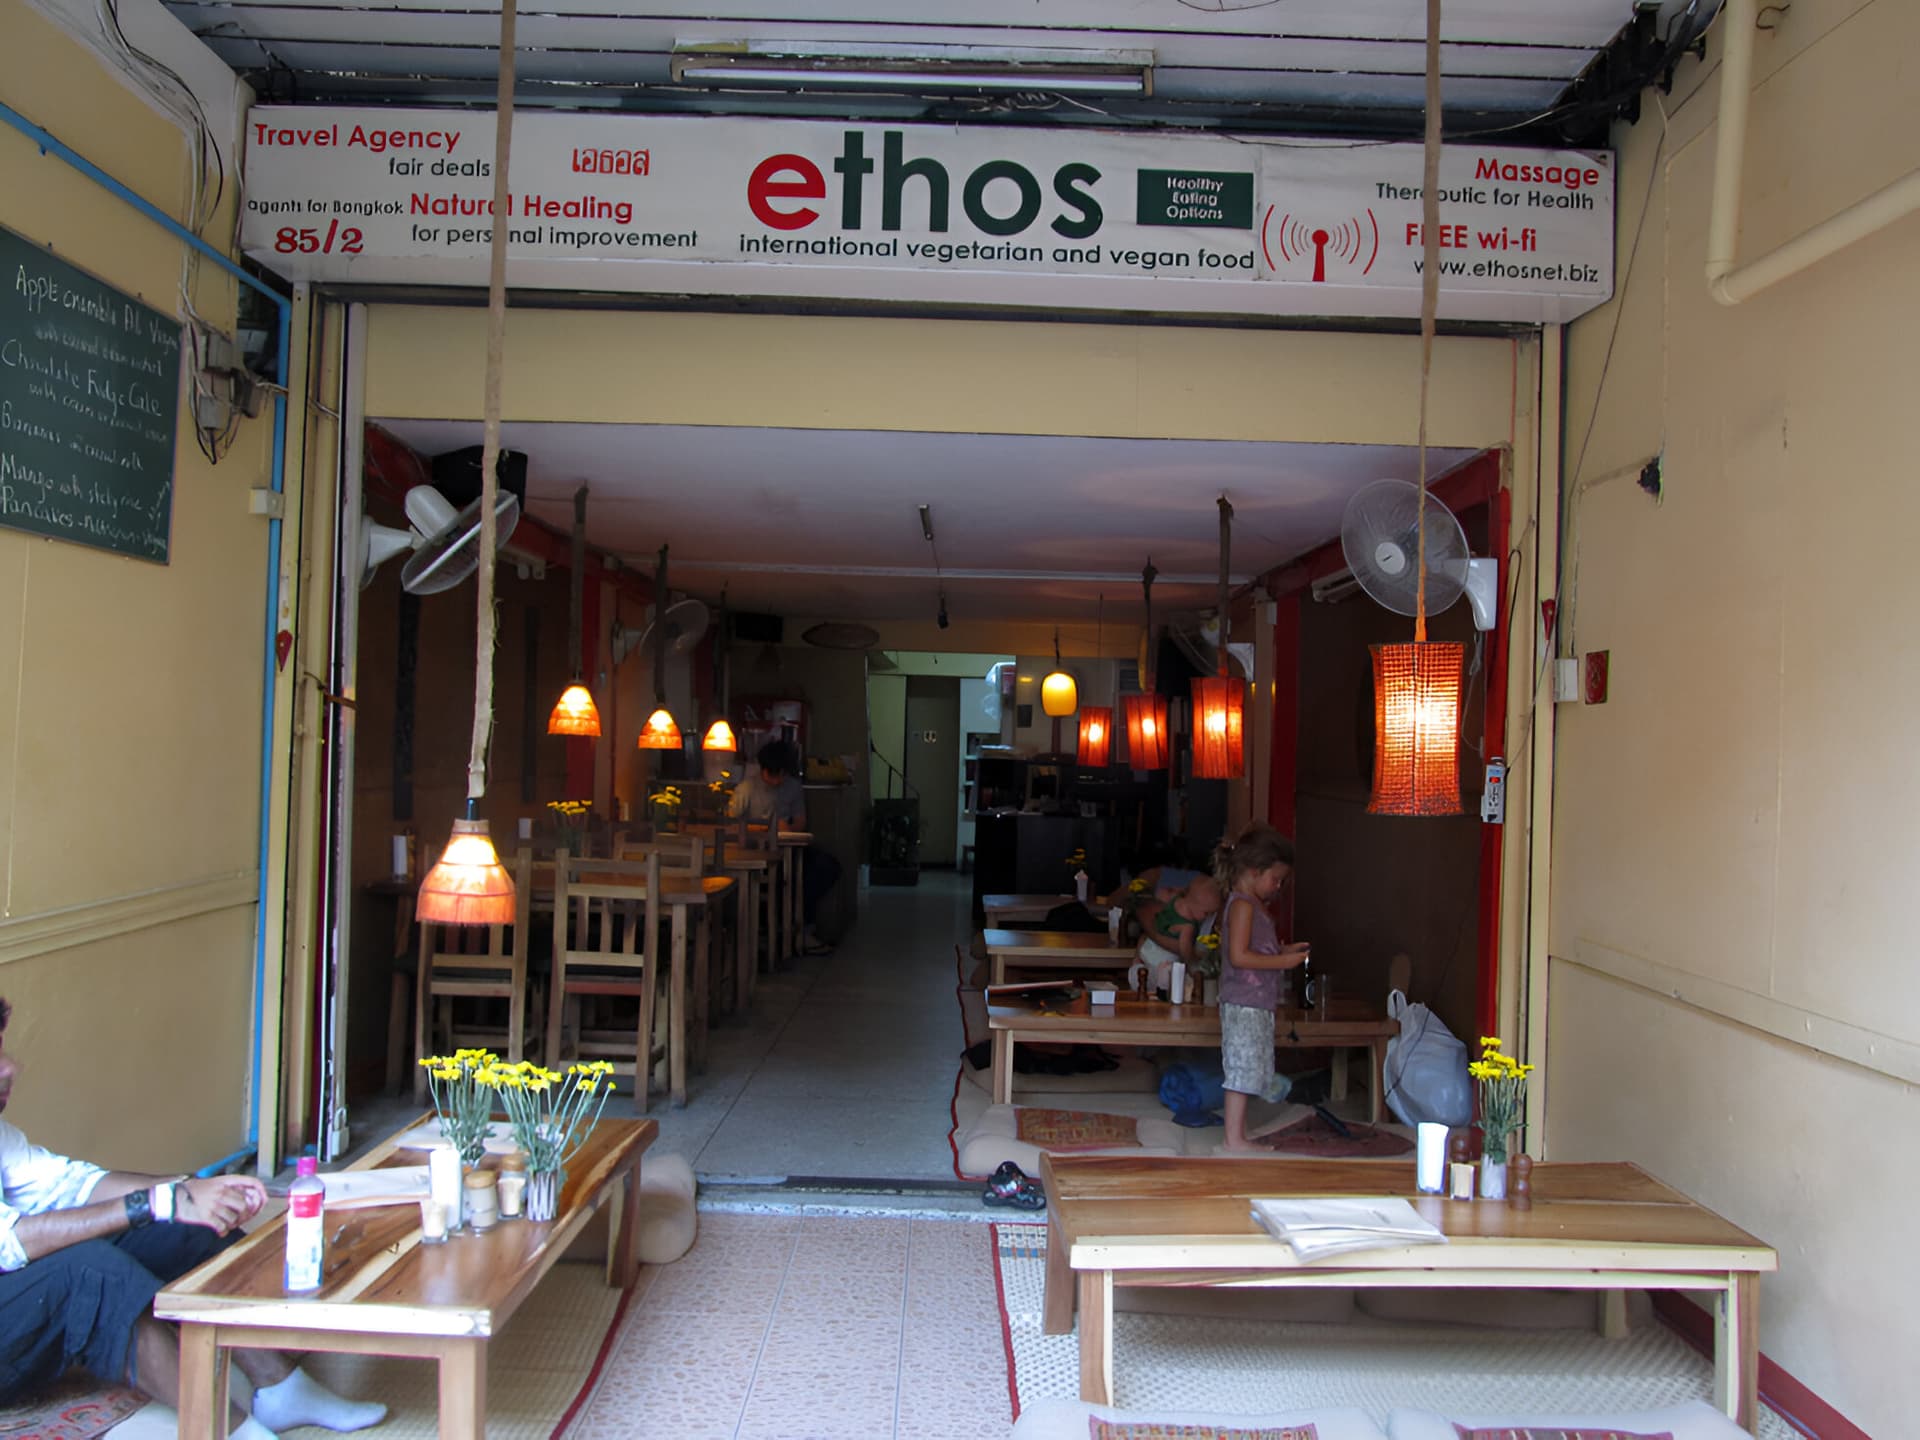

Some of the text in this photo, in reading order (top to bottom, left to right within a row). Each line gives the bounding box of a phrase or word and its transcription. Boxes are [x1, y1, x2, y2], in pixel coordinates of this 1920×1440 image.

[254, 123, 461, 154] Travel Agency
[389, 157, 490, 177] fair deals
[572, 148, 650, 176] เอธอส
[1474, 158, 1599, 189] Massage
[747, 130, 1103, 239] ethos
[1491, 187, 1521, 207] for
[1526, 190, 1594, 211] Health
[523, 194, 633, 226] Healing
[1166, 205, 1223, 220] Options
[274, 218, 364, 254] 85/2
[412, 223, 698, 249] for persnal improvement
[1405, 223, 1537, 252] FEE wi-fi
[740, 233, 1255, 270] international vegetarian and vegan food
